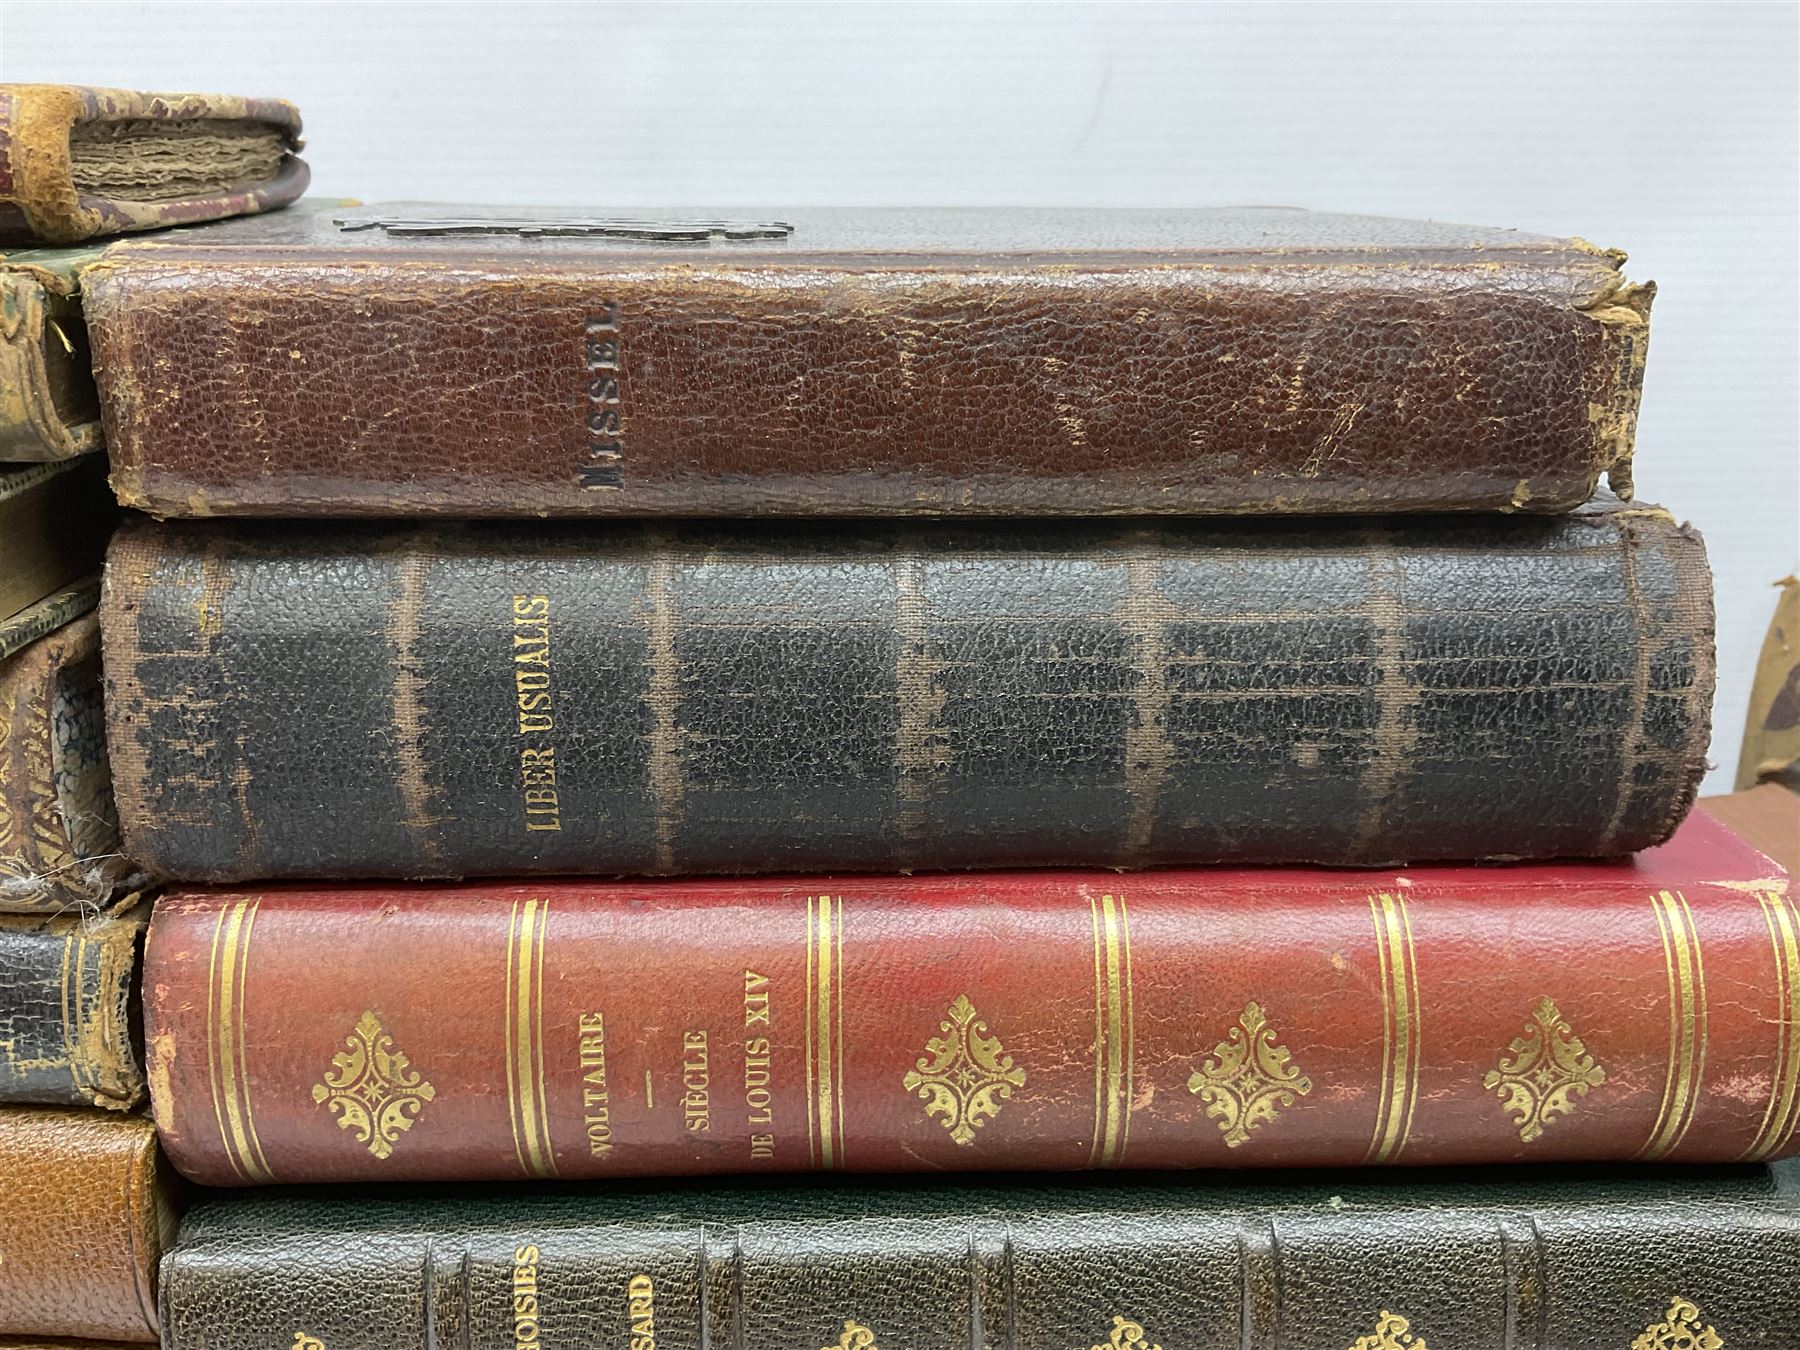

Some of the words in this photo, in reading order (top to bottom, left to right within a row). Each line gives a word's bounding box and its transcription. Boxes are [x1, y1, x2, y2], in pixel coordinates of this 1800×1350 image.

[576, 300, 625, 492] MISSEL
[513, 594, 554, 734] USUALIS
[521, 748, 562, 832] LIBER
[744, 969, 770, 1027] XIV
[579, 1012, 614, 1160] VOLTAIRE
[680, 1030, 710, 1132] SIÈCLE
[745, 1037, 772, 1125] LOUIS
[751, 1133, 775, 1160] DE
